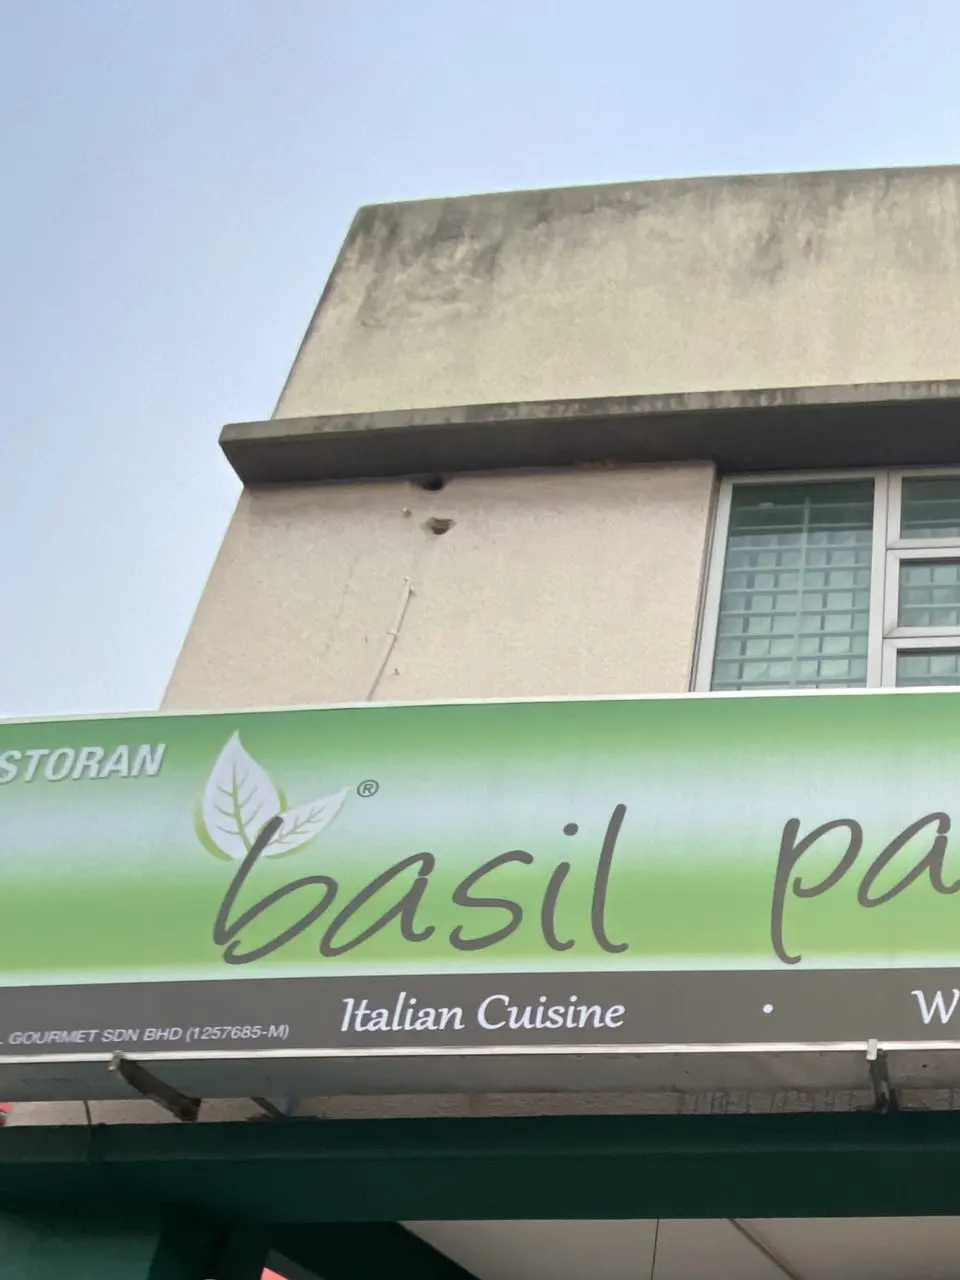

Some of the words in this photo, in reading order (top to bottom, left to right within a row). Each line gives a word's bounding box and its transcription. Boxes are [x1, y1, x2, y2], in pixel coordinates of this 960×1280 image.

[213, 803, 629, 965] basil
[341, 992, 464, 1033] Italian
[477, 994, 626, 1030] Cuisine
[8, 1029, 98, 1045] GOURMET
[101, 1029, 139, 1042] SDN
[143, 1028, 183, 1041] BHD
[185, 1025, 290, 1043] (1257685-M)
